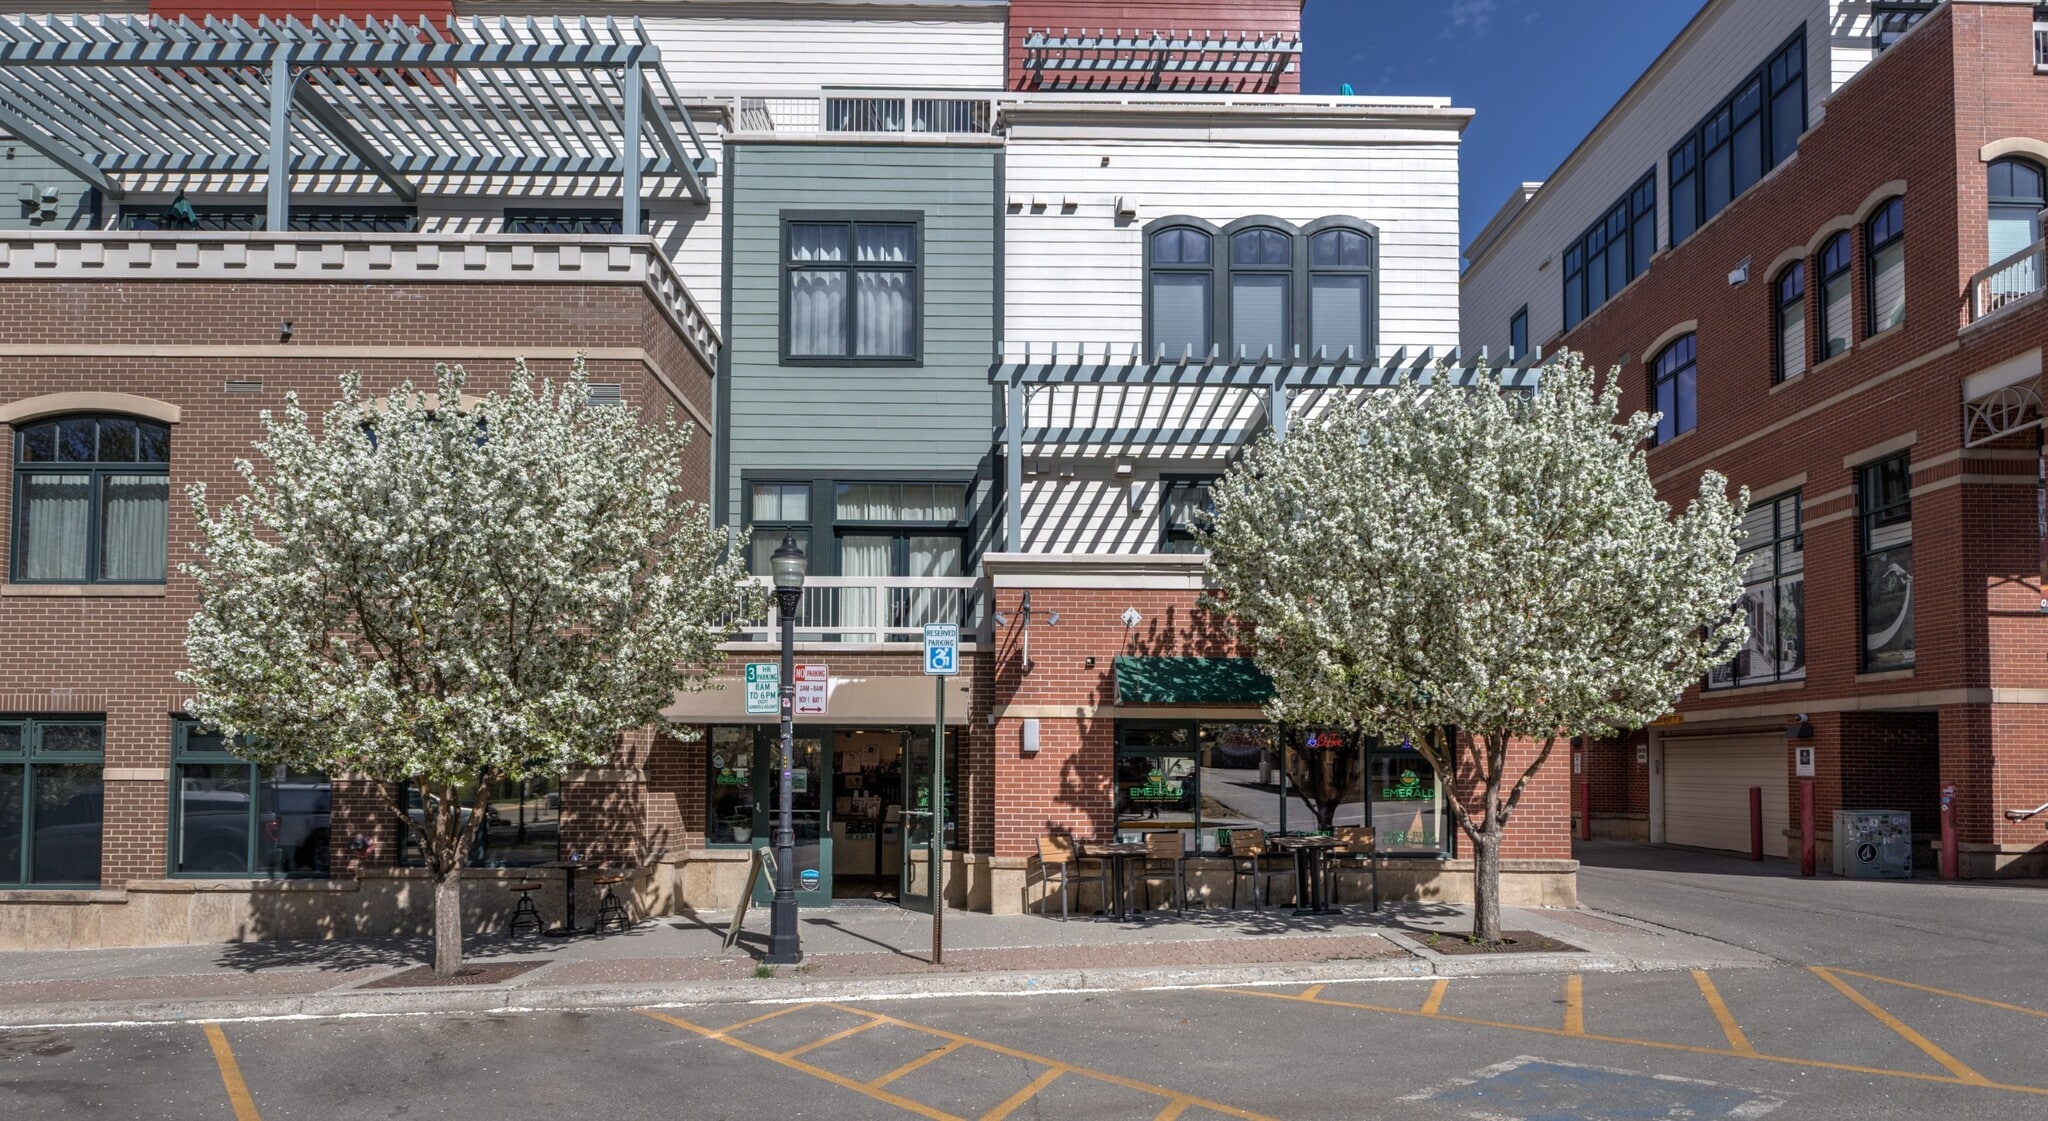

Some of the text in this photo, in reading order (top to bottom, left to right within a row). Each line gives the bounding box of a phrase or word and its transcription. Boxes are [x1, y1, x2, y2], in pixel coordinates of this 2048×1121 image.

[747, 667, 755, 680] 3
[795, 667, 805, 679] NO
[1130, 787, 1183, 797] EMERALD
[1382, 788, 1435, 798] EMERALD
